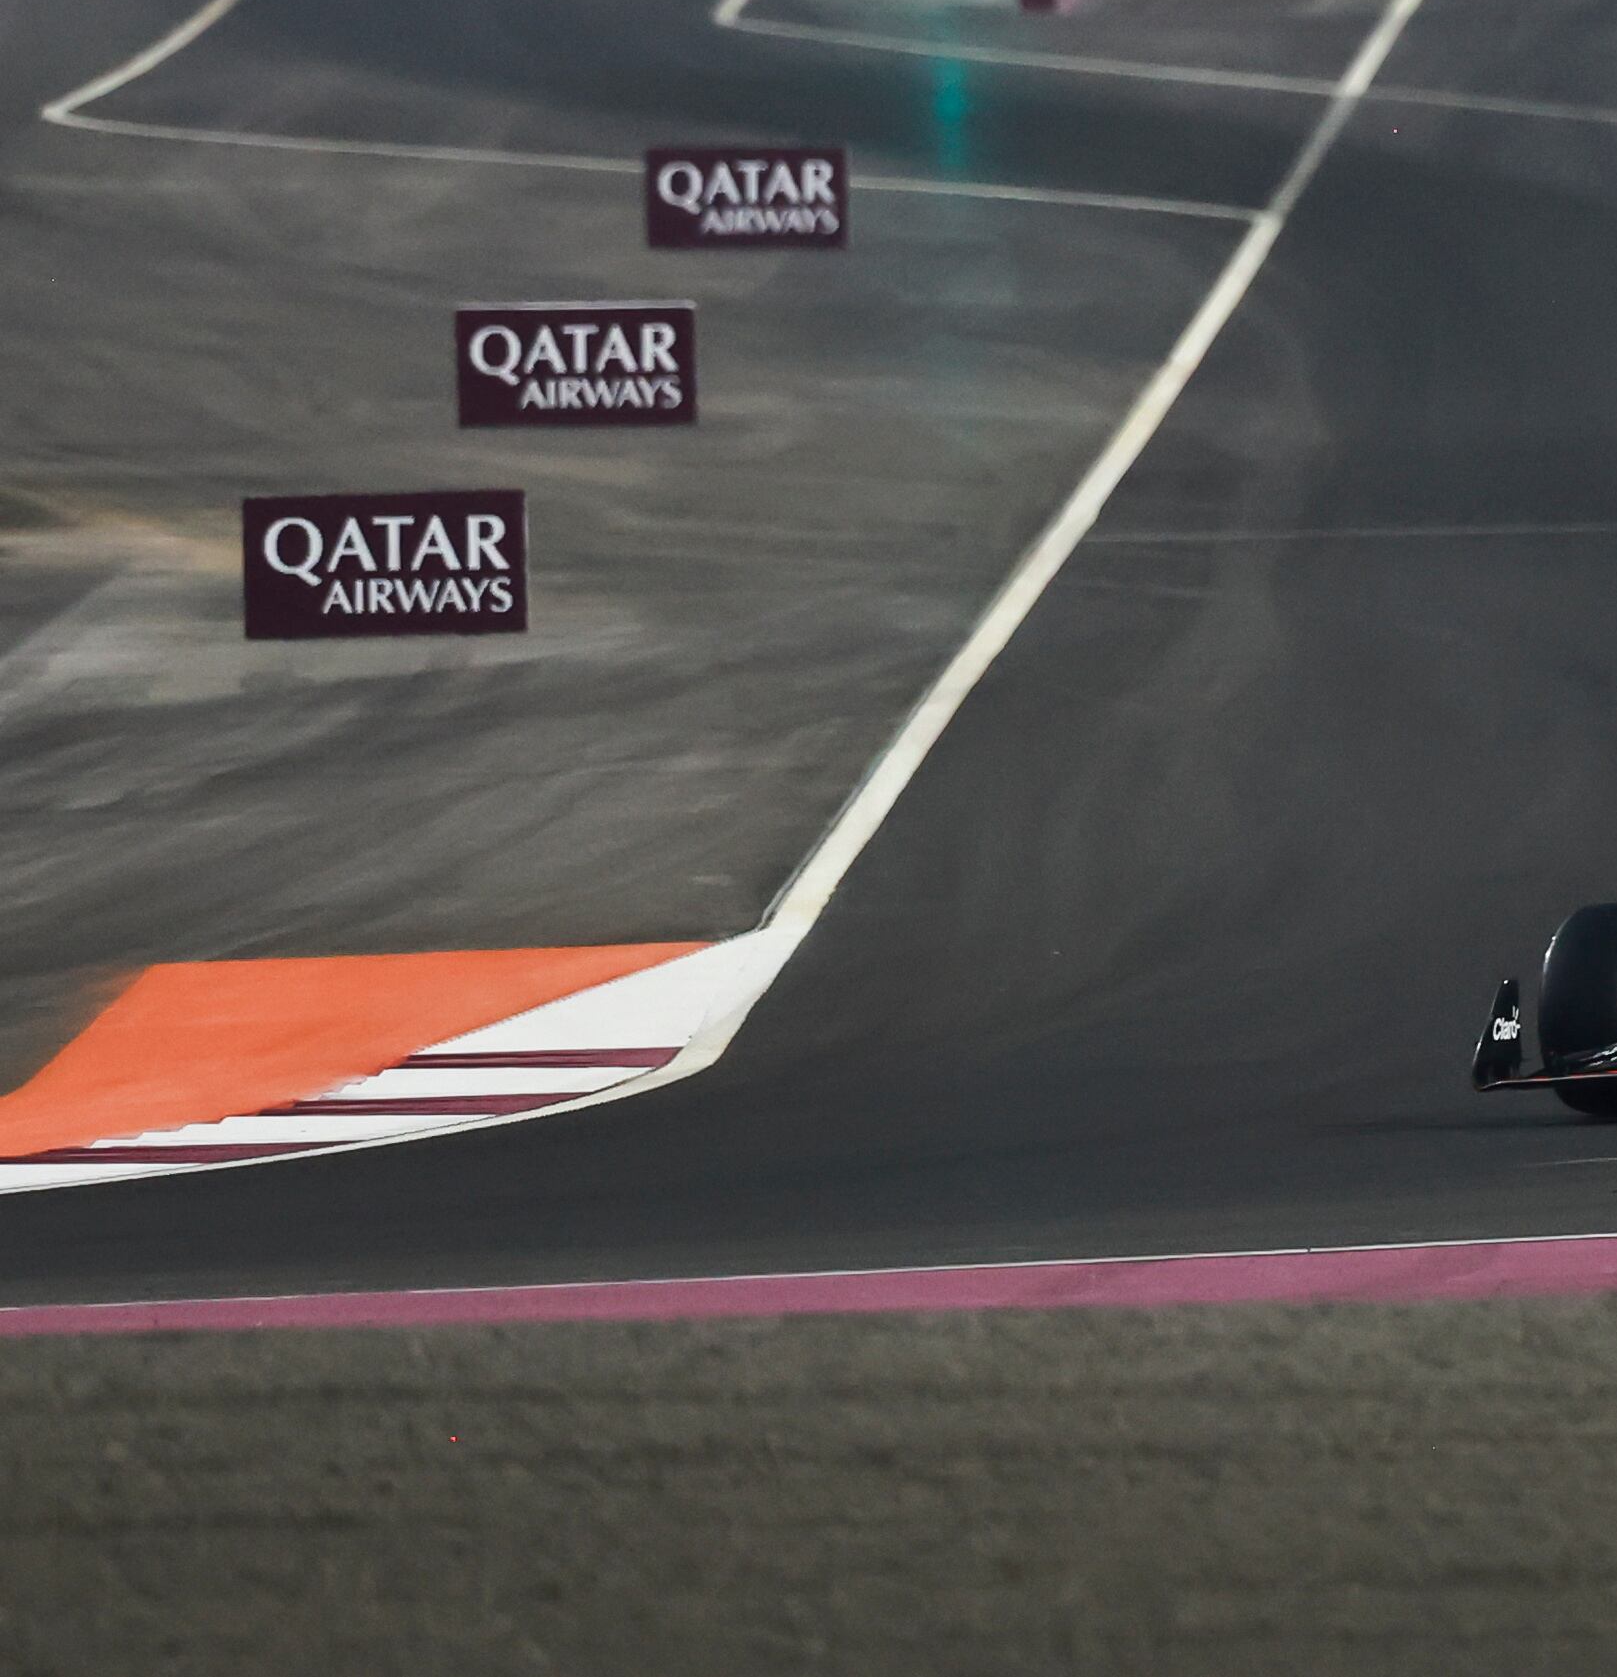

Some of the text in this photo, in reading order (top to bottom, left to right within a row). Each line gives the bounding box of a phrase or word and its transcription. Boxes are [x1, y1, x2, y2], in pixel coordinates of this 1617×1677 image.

[658, 158, 835, 216] QATAR
[469, 323, 679, 386] QATAR
[520, 375, 682, 410] AIRWAYS
[263, 514, 511, 587] QATAR
[322, 575, 514, 614] AIRWAYS
